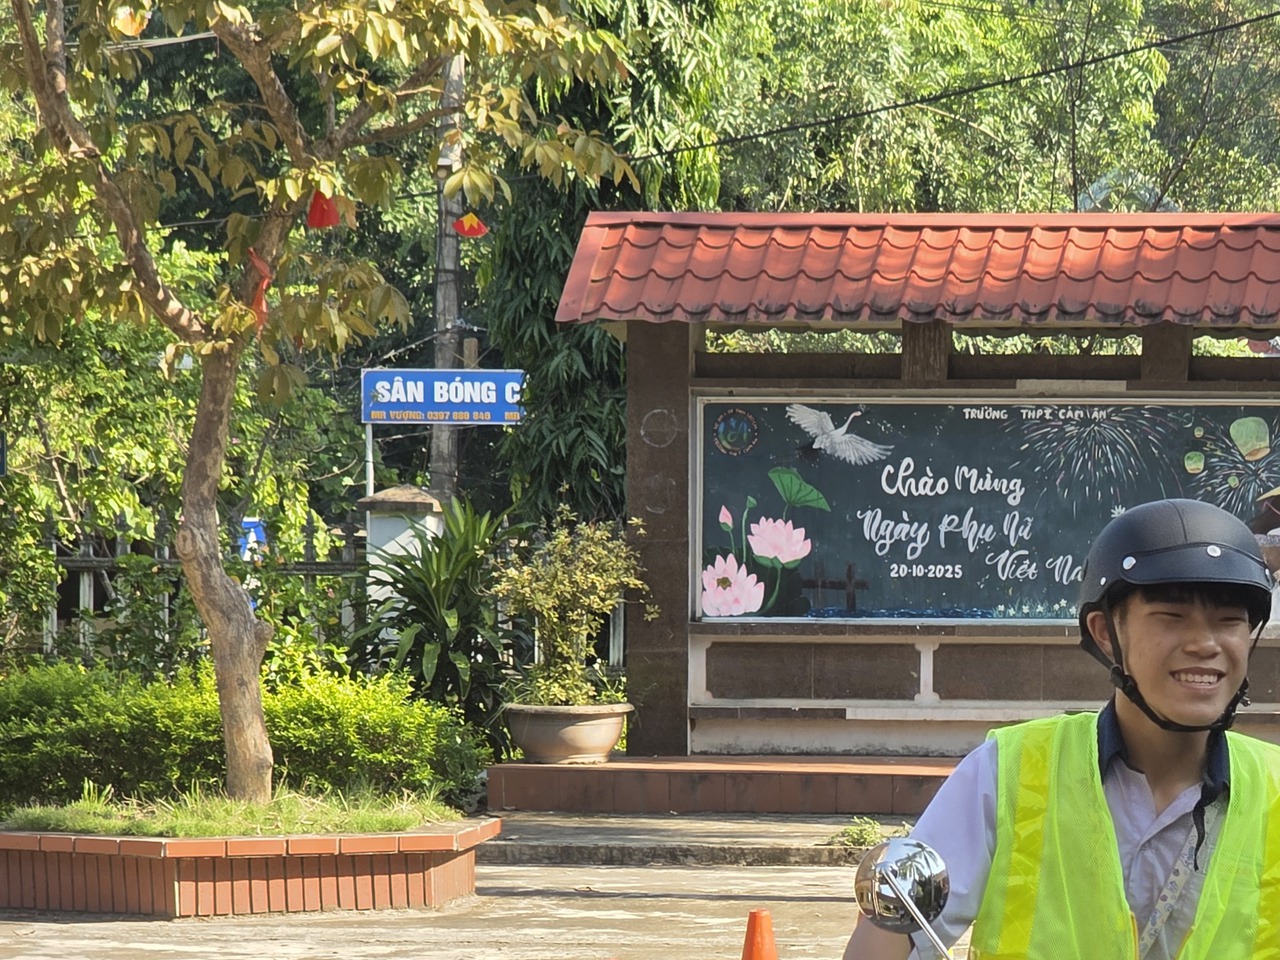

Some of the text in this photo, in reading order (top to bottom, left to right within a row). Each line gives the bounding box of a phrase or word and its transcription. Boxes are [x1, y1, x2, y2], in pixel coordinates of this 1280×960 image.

[375, 376, 521, 404] SÂN BÓNG C
[962, 405, 1009, 420] TRƯỜNG
[1020, 408, 1053, 420] THPT
[880, 457, 1026, 506] Chào Mừng
[856, 508, 931, 560] Ngày
[985, 549, 1084, 585] Việt Na
